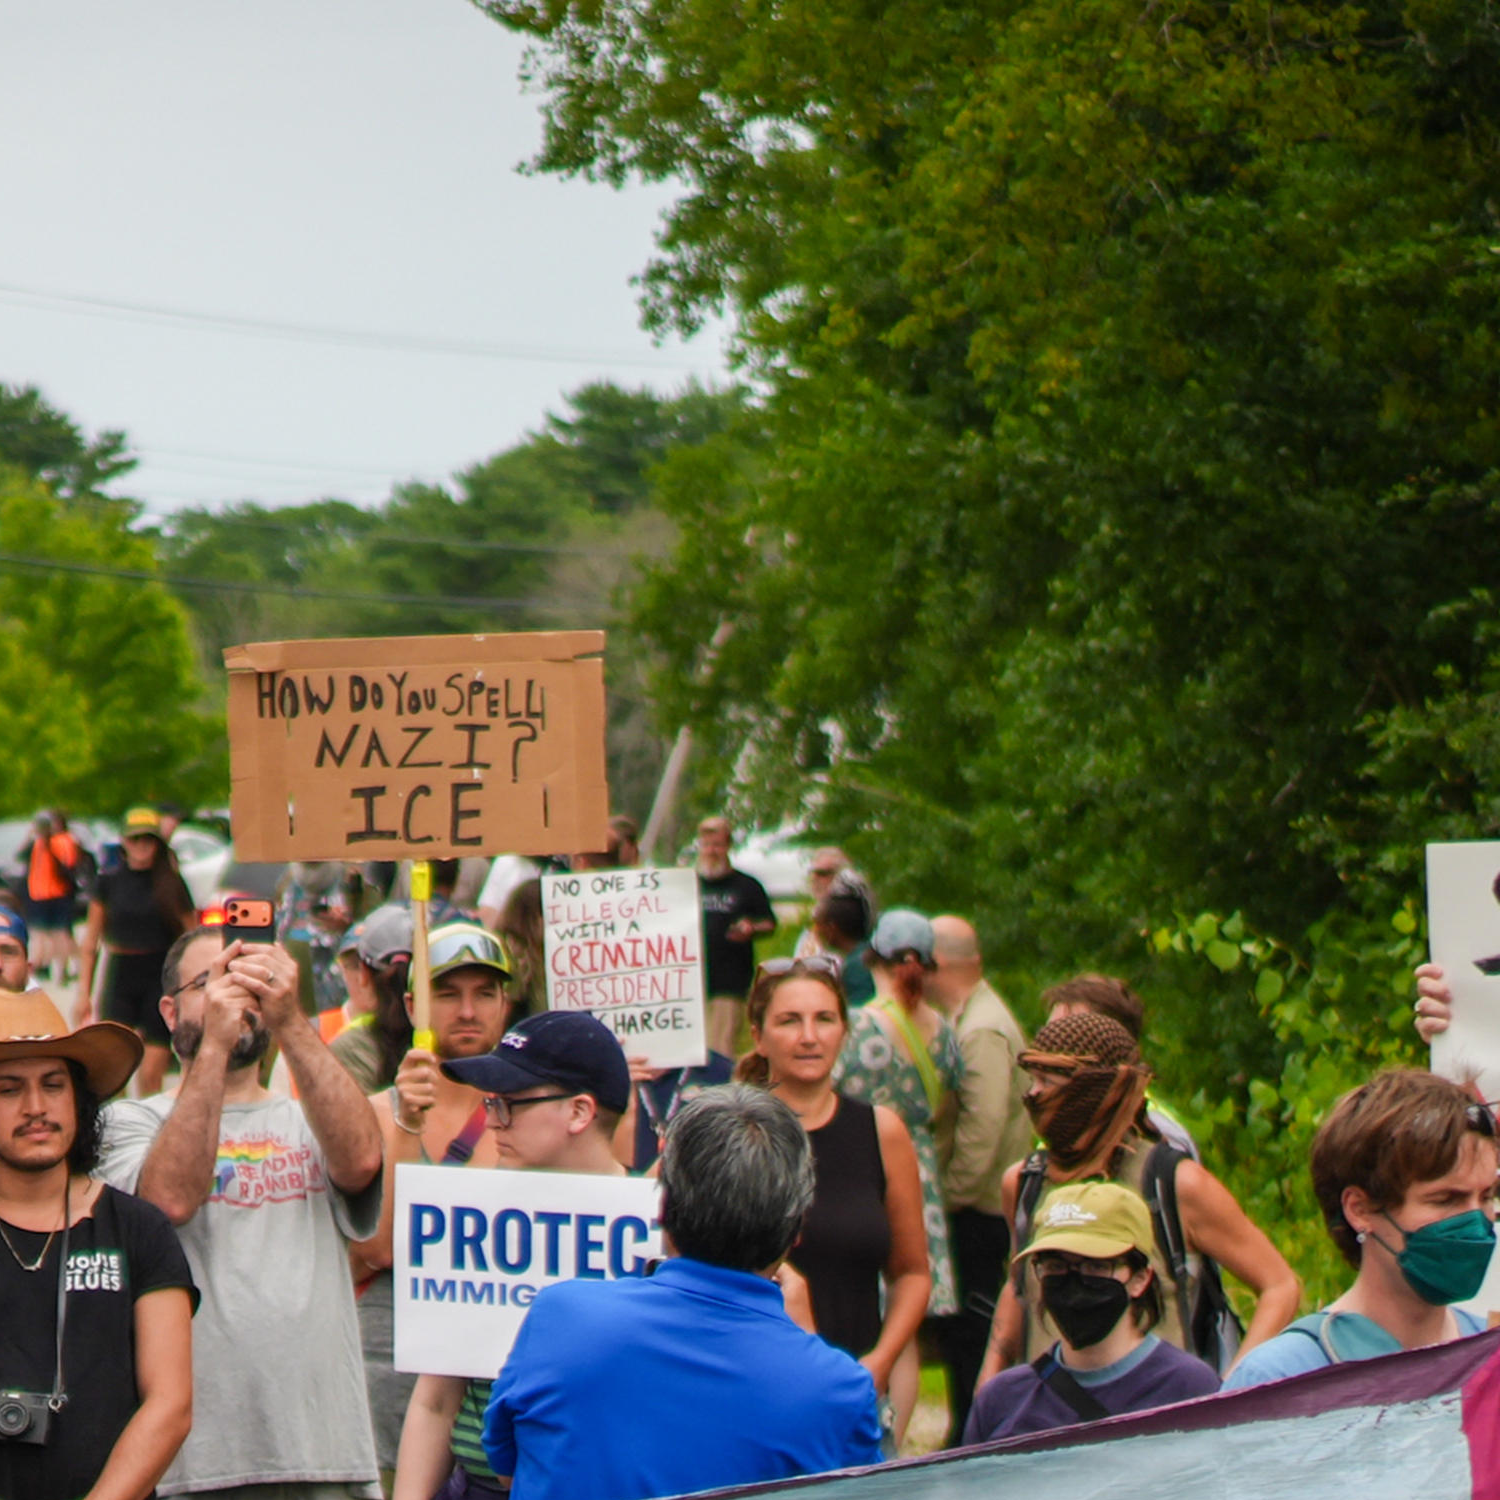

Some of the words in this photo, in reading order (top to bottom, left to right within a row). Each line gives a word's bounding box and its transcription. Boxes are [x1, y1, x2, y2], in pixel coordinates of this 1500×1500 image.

[256, 672, 336, 719] HOW
[442, 673, 544, 720] SPELL
[314, 720, 539, 784] NAZI?
[552, 879, 580, 899] NO
[591, 874, 626, 895] ONE
[635, 871, 660, 891] IS
[547, 895, 669, 925] ILLEGAL
[554, 920, 615, 941] WITH
[626, 920, 640, 936] A
[551, 933, 697, 977] CRIMINAL
[554, 968, 689, 1010] PRESIDENT
[65, 1273, 121, 1291] BLUES
[410, 1276, 540, 1308] IMMIG
